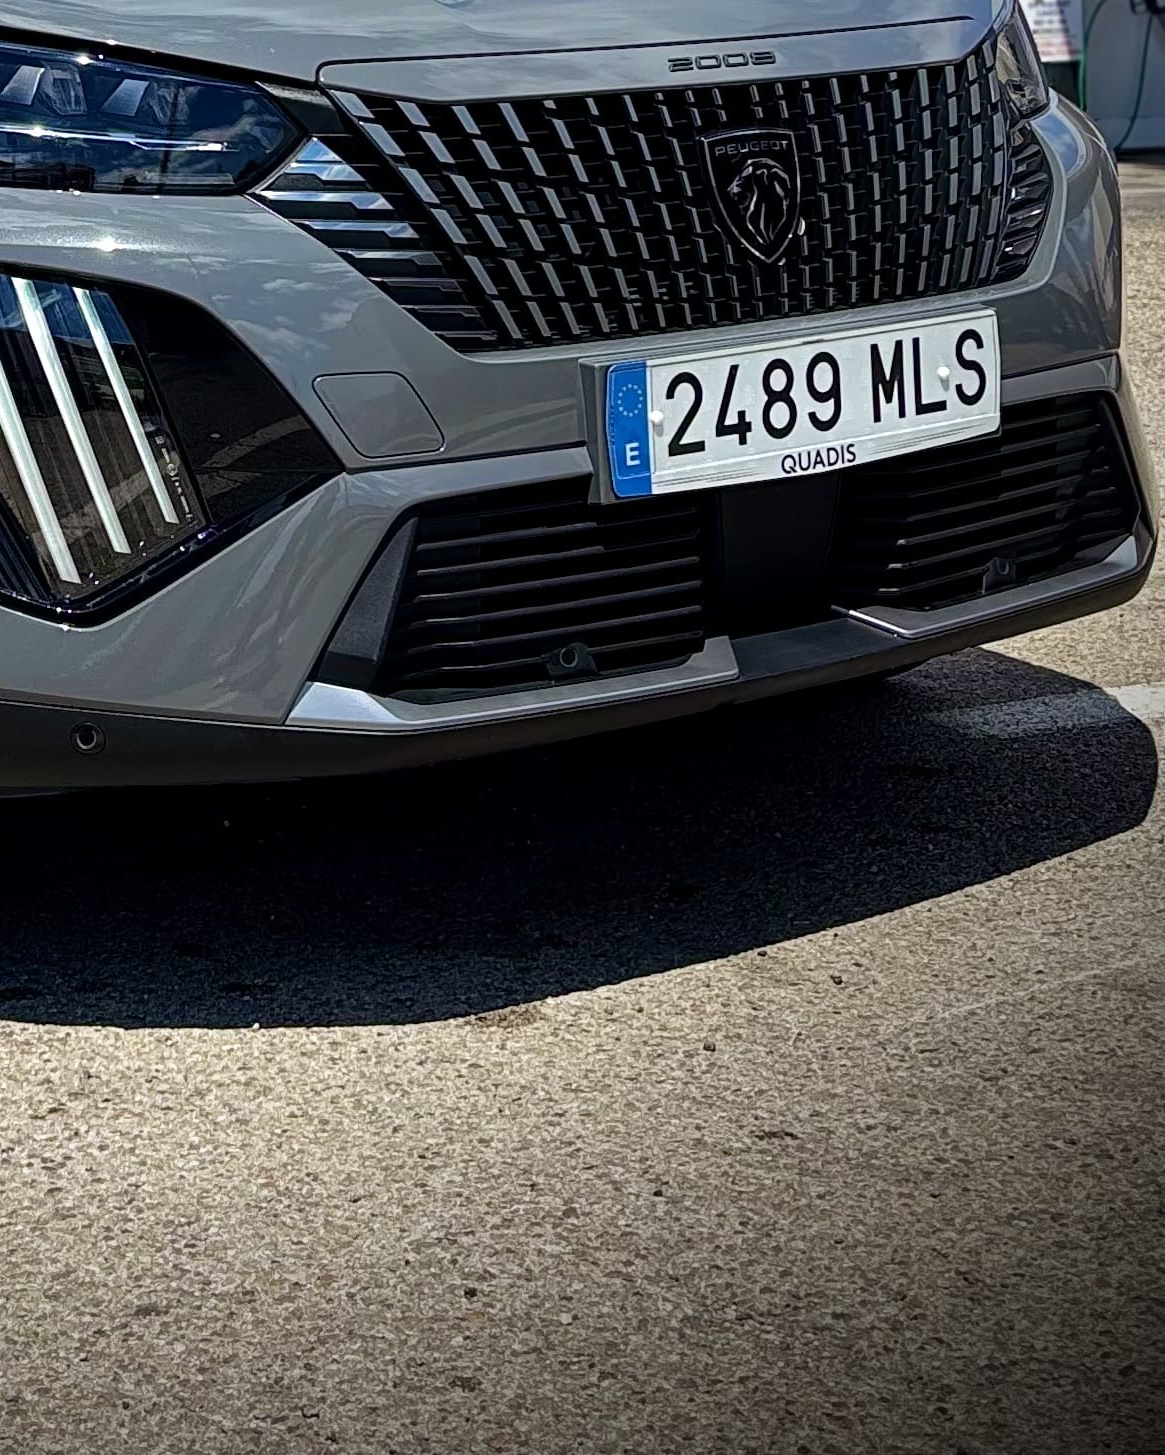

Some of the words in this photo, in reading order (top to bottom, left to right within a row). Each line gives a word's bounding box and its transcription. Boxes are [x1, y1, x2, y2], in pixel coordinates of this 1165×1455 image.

[668, 51, 776, 72] 2008
[715, 141, 788, 156] PEUGEOT
[666, 351, 842, 456] 2489
[870, 329, 986, 423] MLS
[625, 442, 641, 466] E
[781, 443, 856, 475] QUADIS
